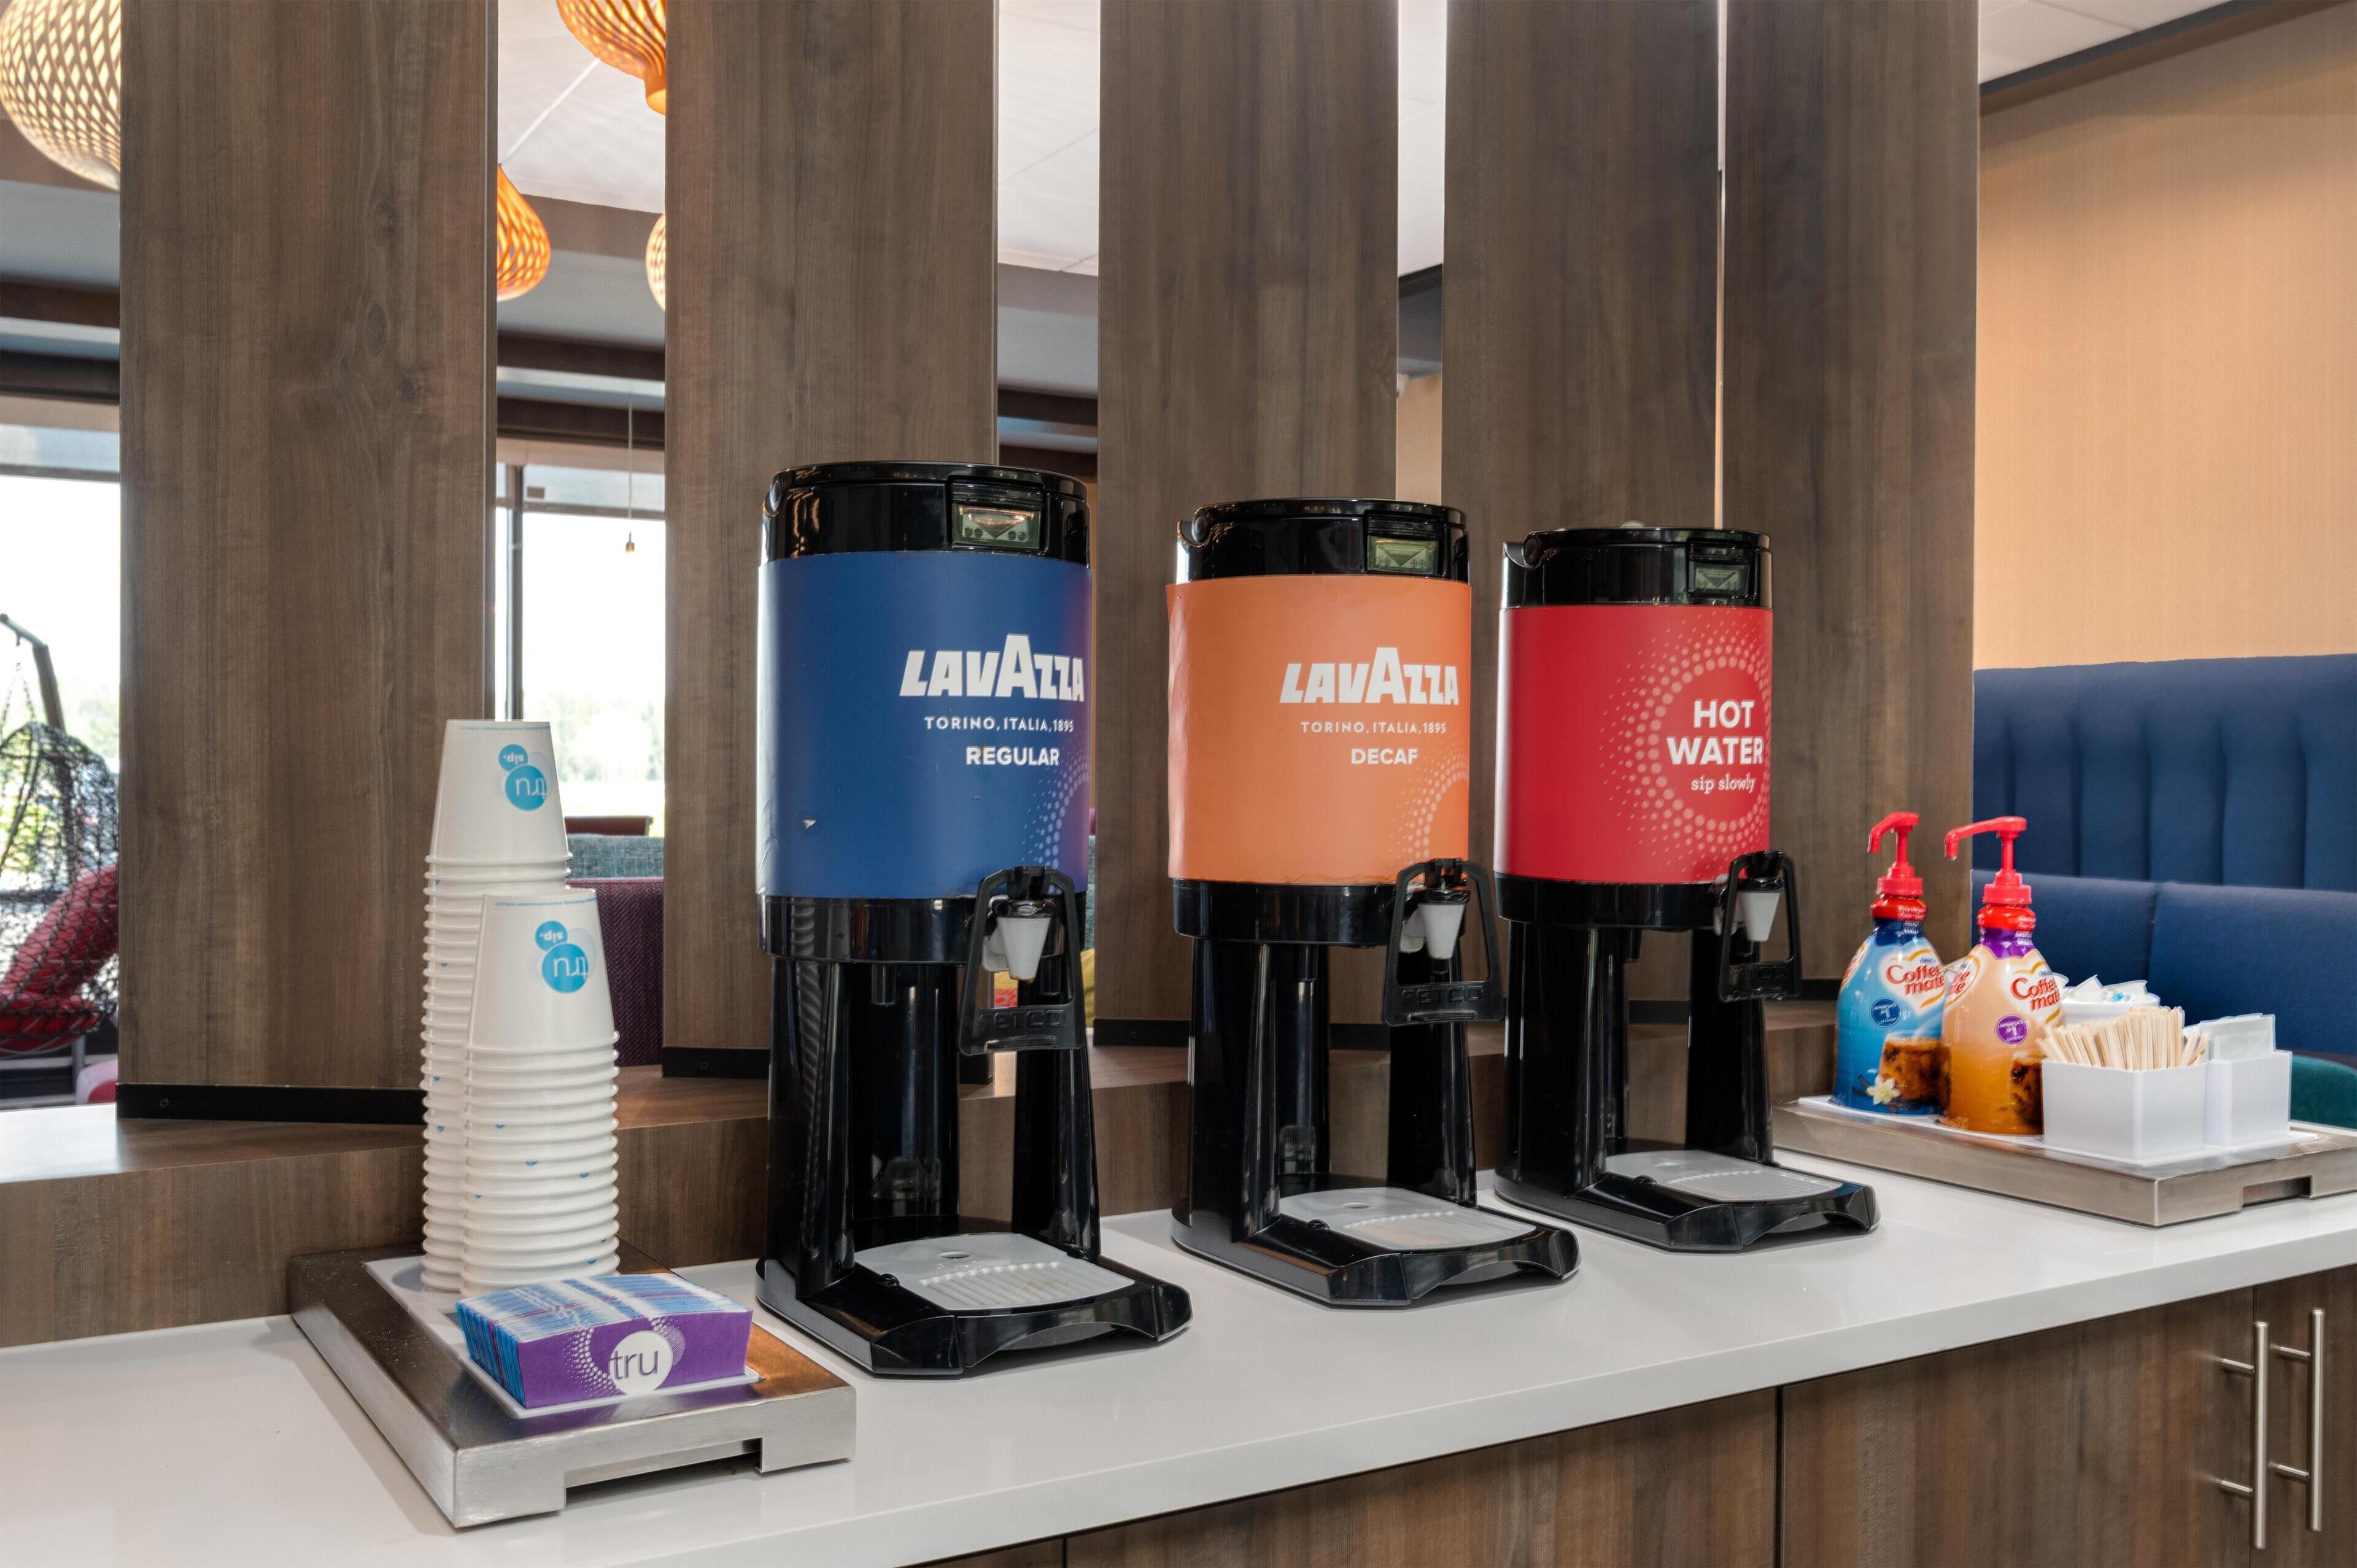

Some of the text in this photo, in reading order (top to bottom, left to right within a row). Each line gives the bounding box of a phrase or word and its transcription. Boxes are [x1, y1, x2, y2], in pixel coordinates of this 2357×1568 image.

[899, 633, 1085, 702] LAVAZZA
[1279, 647, 1459, 706] LAVAZZA
[924, 716, 1075, 733] TORINO, ITALIA, 1895
[1693, 699, 1755, 729] HOT
[1301, 721, 1447, 735] TORINO, ITALIA, 1895
[966, 746, 1061, 766] REGULAR
[1351, 748, 1418, 765] DECAF
[1666, 736, 1765, 766] WATER
[516, 777, 547, 801] tru
[1690, 771, 1756, 795] sip slowly
[553, 956, 589, 982] tru
[1886, 964, 1941, 985] Coffee
[1905, 975, 1945, 995] mate
[608, 1349, 659, 1380] tru
